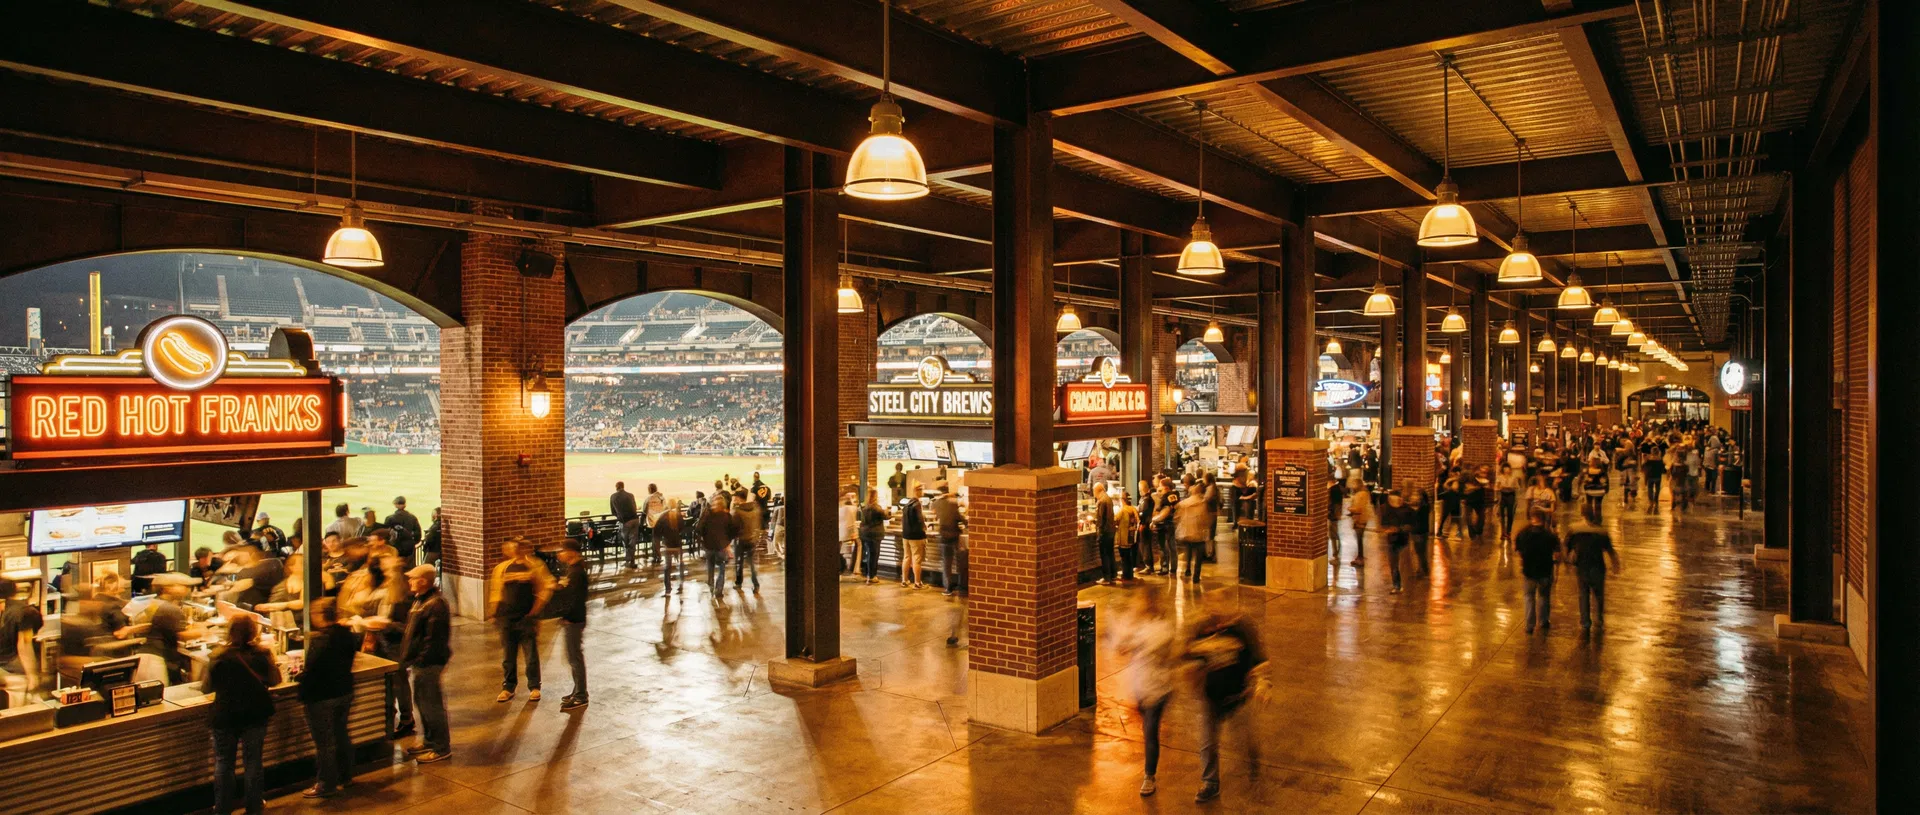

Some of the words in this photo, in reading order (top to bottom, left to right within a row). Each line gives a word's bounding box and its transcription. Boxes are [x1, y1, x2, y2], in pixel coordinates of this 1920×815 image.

[869, 391, 908, 413] STEEL
[910, 391, 940, 413] CITY
[943, 391, 993, 414] BREWS
[1069, 390, 1107, 412] CRACKER
[1108, 390, 1127, 411] JACK
[1128, 391, 1134, 411] &
[1135, 390, 1147, 411] CO.
[31, 396, 107, 438] RED
[120, 395, 190, 436] HOT
[200, 394, 322, 433] FRANKS
